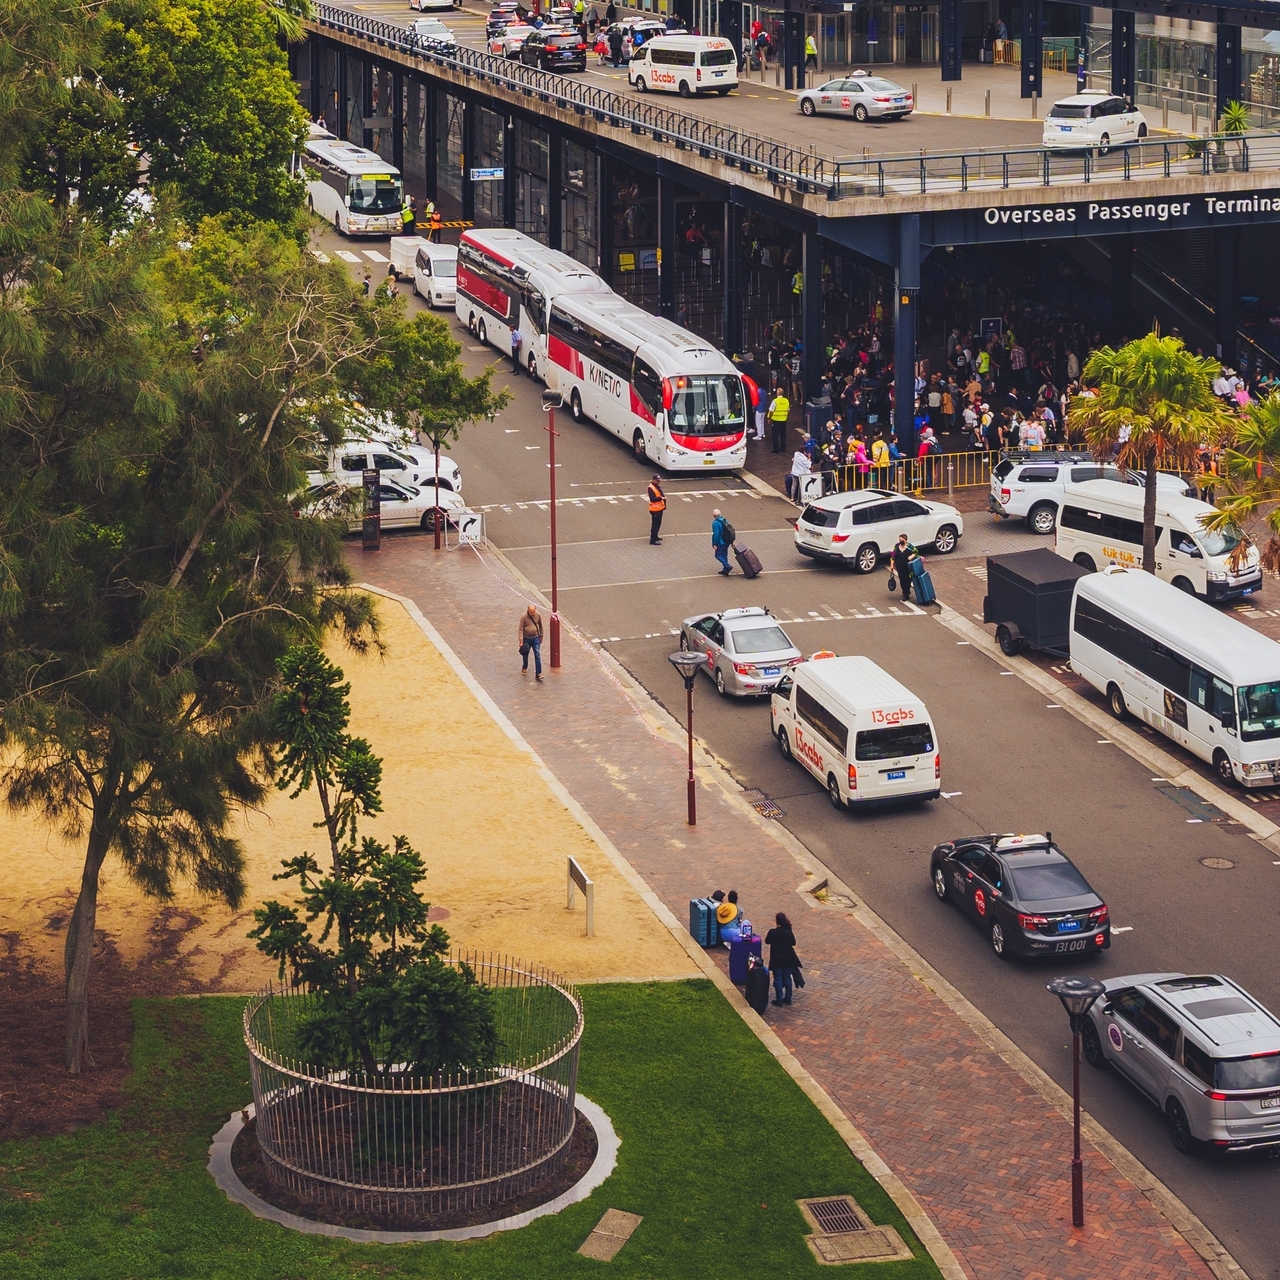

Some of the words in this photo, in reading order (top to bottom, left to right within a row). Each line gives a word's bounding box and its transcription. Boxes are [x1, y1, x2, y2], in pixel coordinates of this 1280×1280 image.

[706, 41, 726, 49] 13cabs
[651, 69, 676, 84] 13cabs
[984, 207, 1076, 225] Overseas
[1088, 200, 1191, 221] Passenger
[1102, 546, 1118, 559] tük
[1119, 550, 1135, 563] tük
[871, 708, 914, 723] 13cabs
[795, 727, 824, 771] 13cabs
[1055, 942, 1069, 952] 131
[1070, 940, 1086, 950] 001
